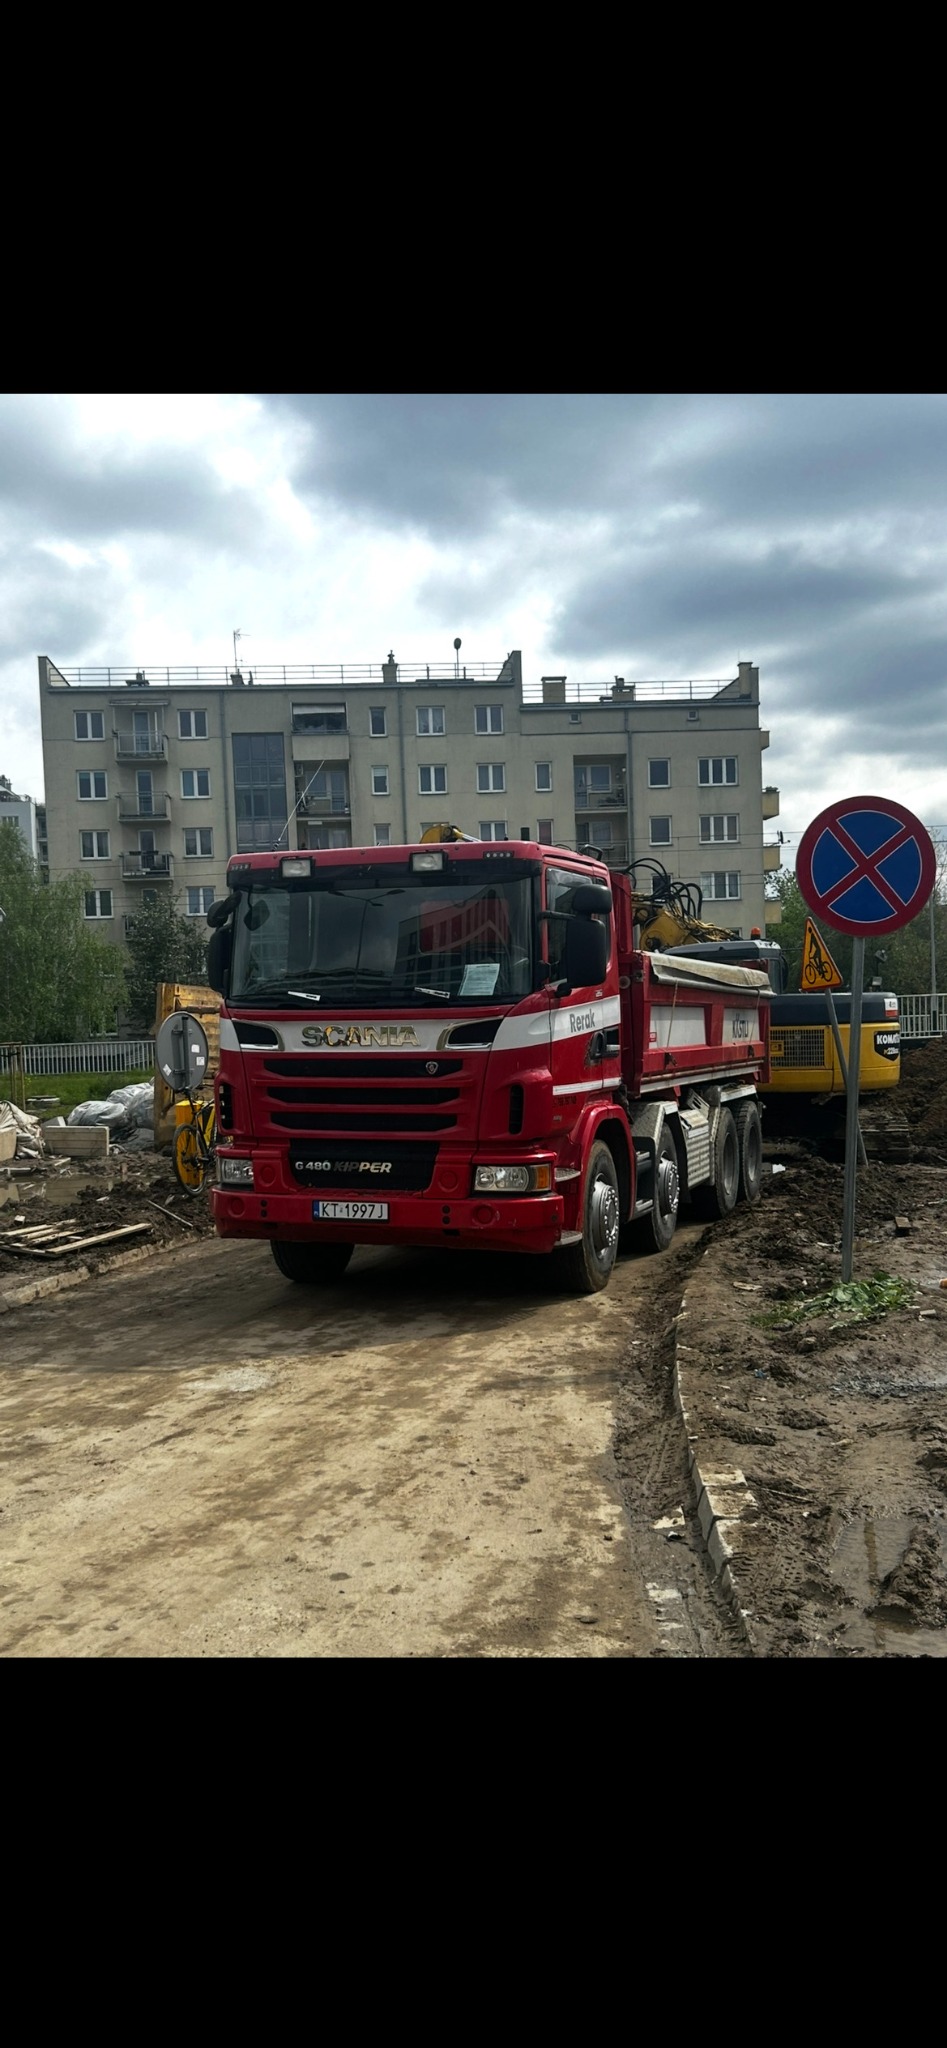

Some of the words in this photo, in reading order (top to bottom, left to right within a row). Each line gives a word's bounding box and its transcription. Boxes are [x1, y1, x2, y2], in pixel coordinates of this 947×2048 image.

[570, 1008, 595, 1033] Rerak
[301, 1025, 420, 1047] SCANIA
[876, 1033, 900, 1045] KOMA
[295, 1161, 304, 1170] G
[305, 1161, 331, 1171] 480
[334, 1161, 392, 1173] KIPPER
[322, 1203, 338, 1217] KT
[345, 1203, 383, 1219] 1997J
